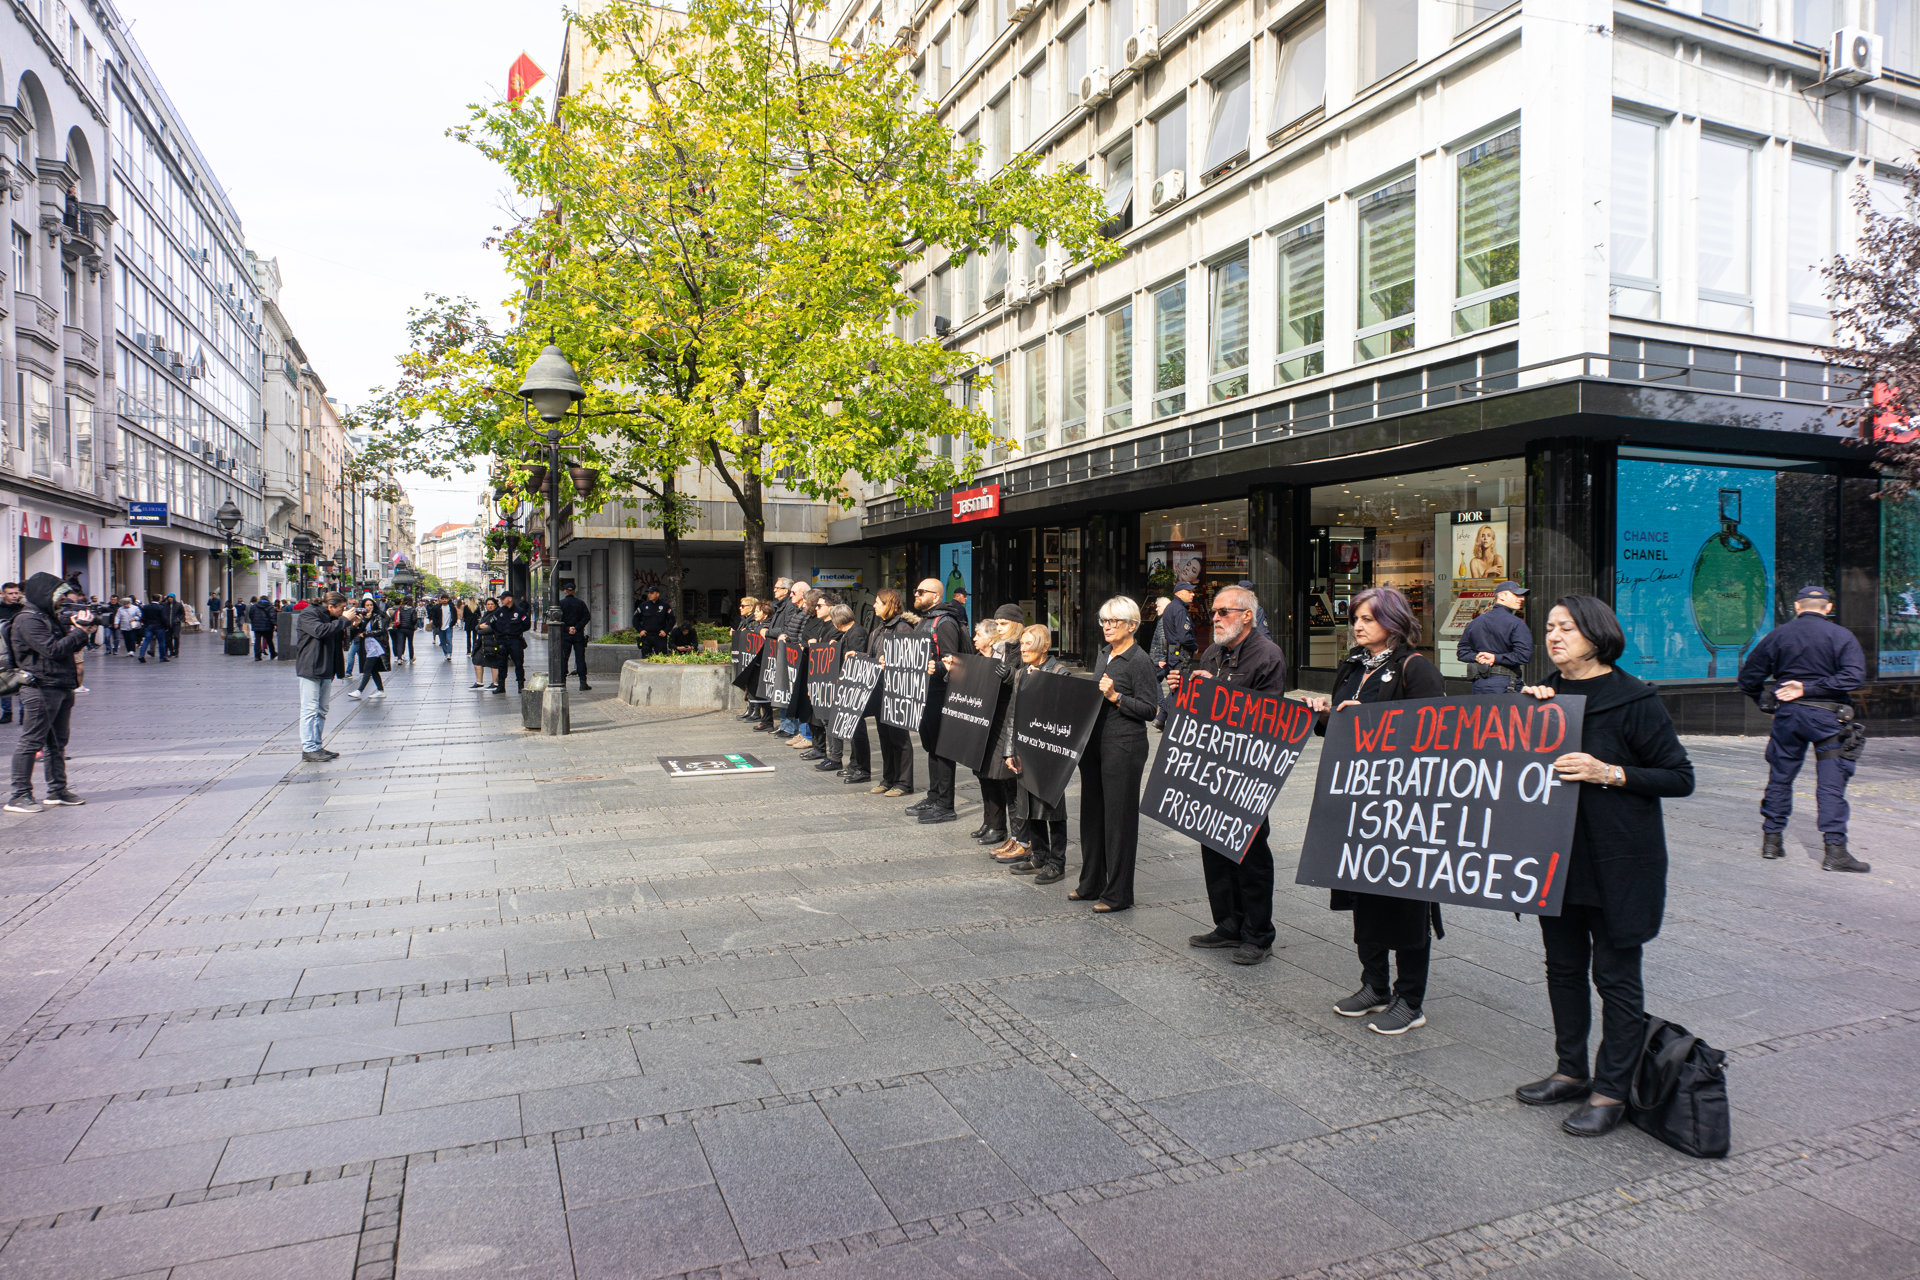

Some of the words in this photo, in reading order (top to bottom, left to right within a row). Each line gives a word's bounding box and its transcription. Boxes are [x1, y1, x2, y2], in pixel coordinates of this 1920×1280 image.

[954, 488, 993, 517] Jasmin
[1458, 511, 1483, 522] DIOR
[121, 531, 138, 547] A1
[1623, 530, 1669, 543] CHANCE
[1623, 548, 1668, 561] CHANEL
[809, 646, 836, 676] STOP
[1175, 676, 1203, 715] WE
[1210, 685, 1313, 744] DEMAND
[1354, 709, 1404, 753] WE
[1410, 703, 1567, 753] DEMAND
[1273, 748, 1300, 777] OF
[1329, 756, 1503, 801] LIBERATION
[1517, 761, 1563, 805] OF
[1347, 799, 1492, 849] ISRAELI
